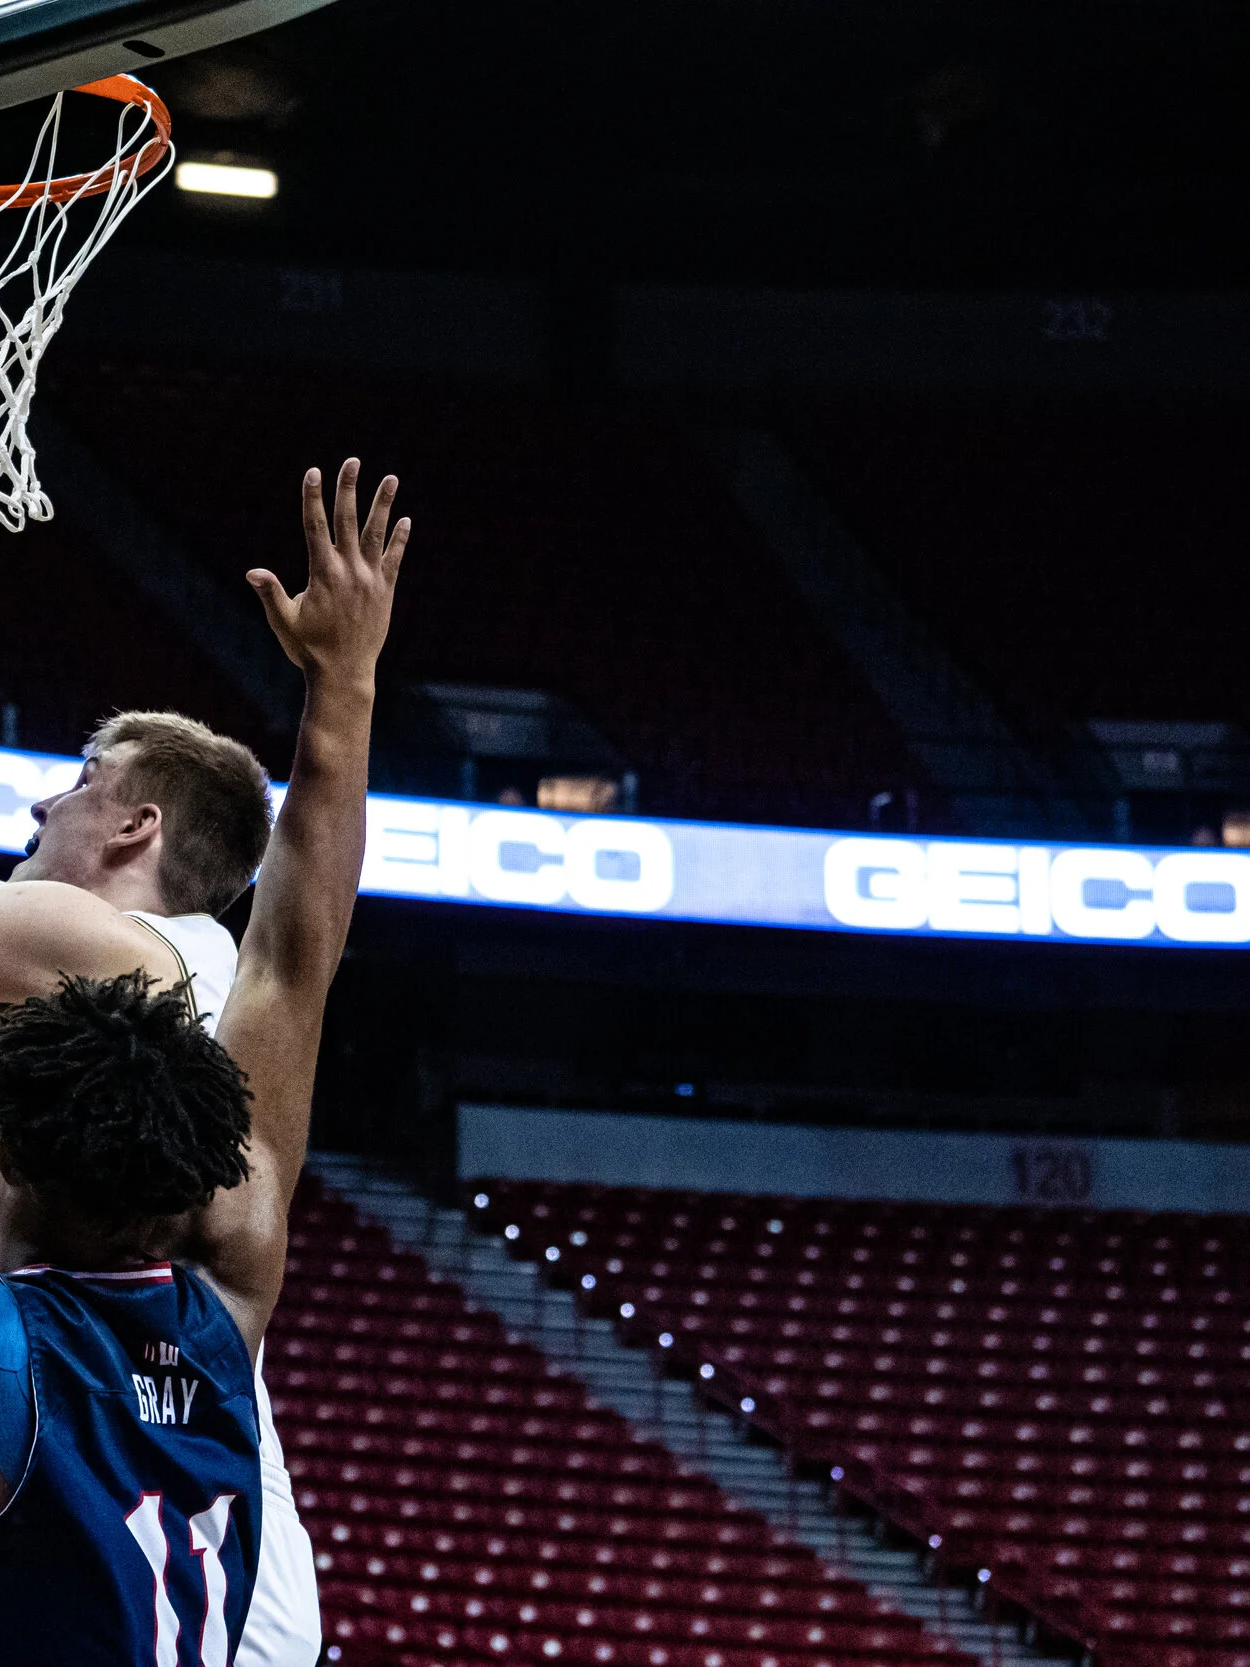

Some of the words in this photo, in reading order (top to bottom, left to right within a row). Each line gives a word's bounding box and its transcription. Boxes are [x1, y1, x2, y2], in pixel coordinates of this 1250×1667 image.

[258, 792, 674, 912] EICO
[824, 838, 1250, 942] GEICO
[1011, 1146, 1093, 1200] 120
[131, 1373, 200, 1424] GRAY
[124, 1490, 240, 1667] 11
